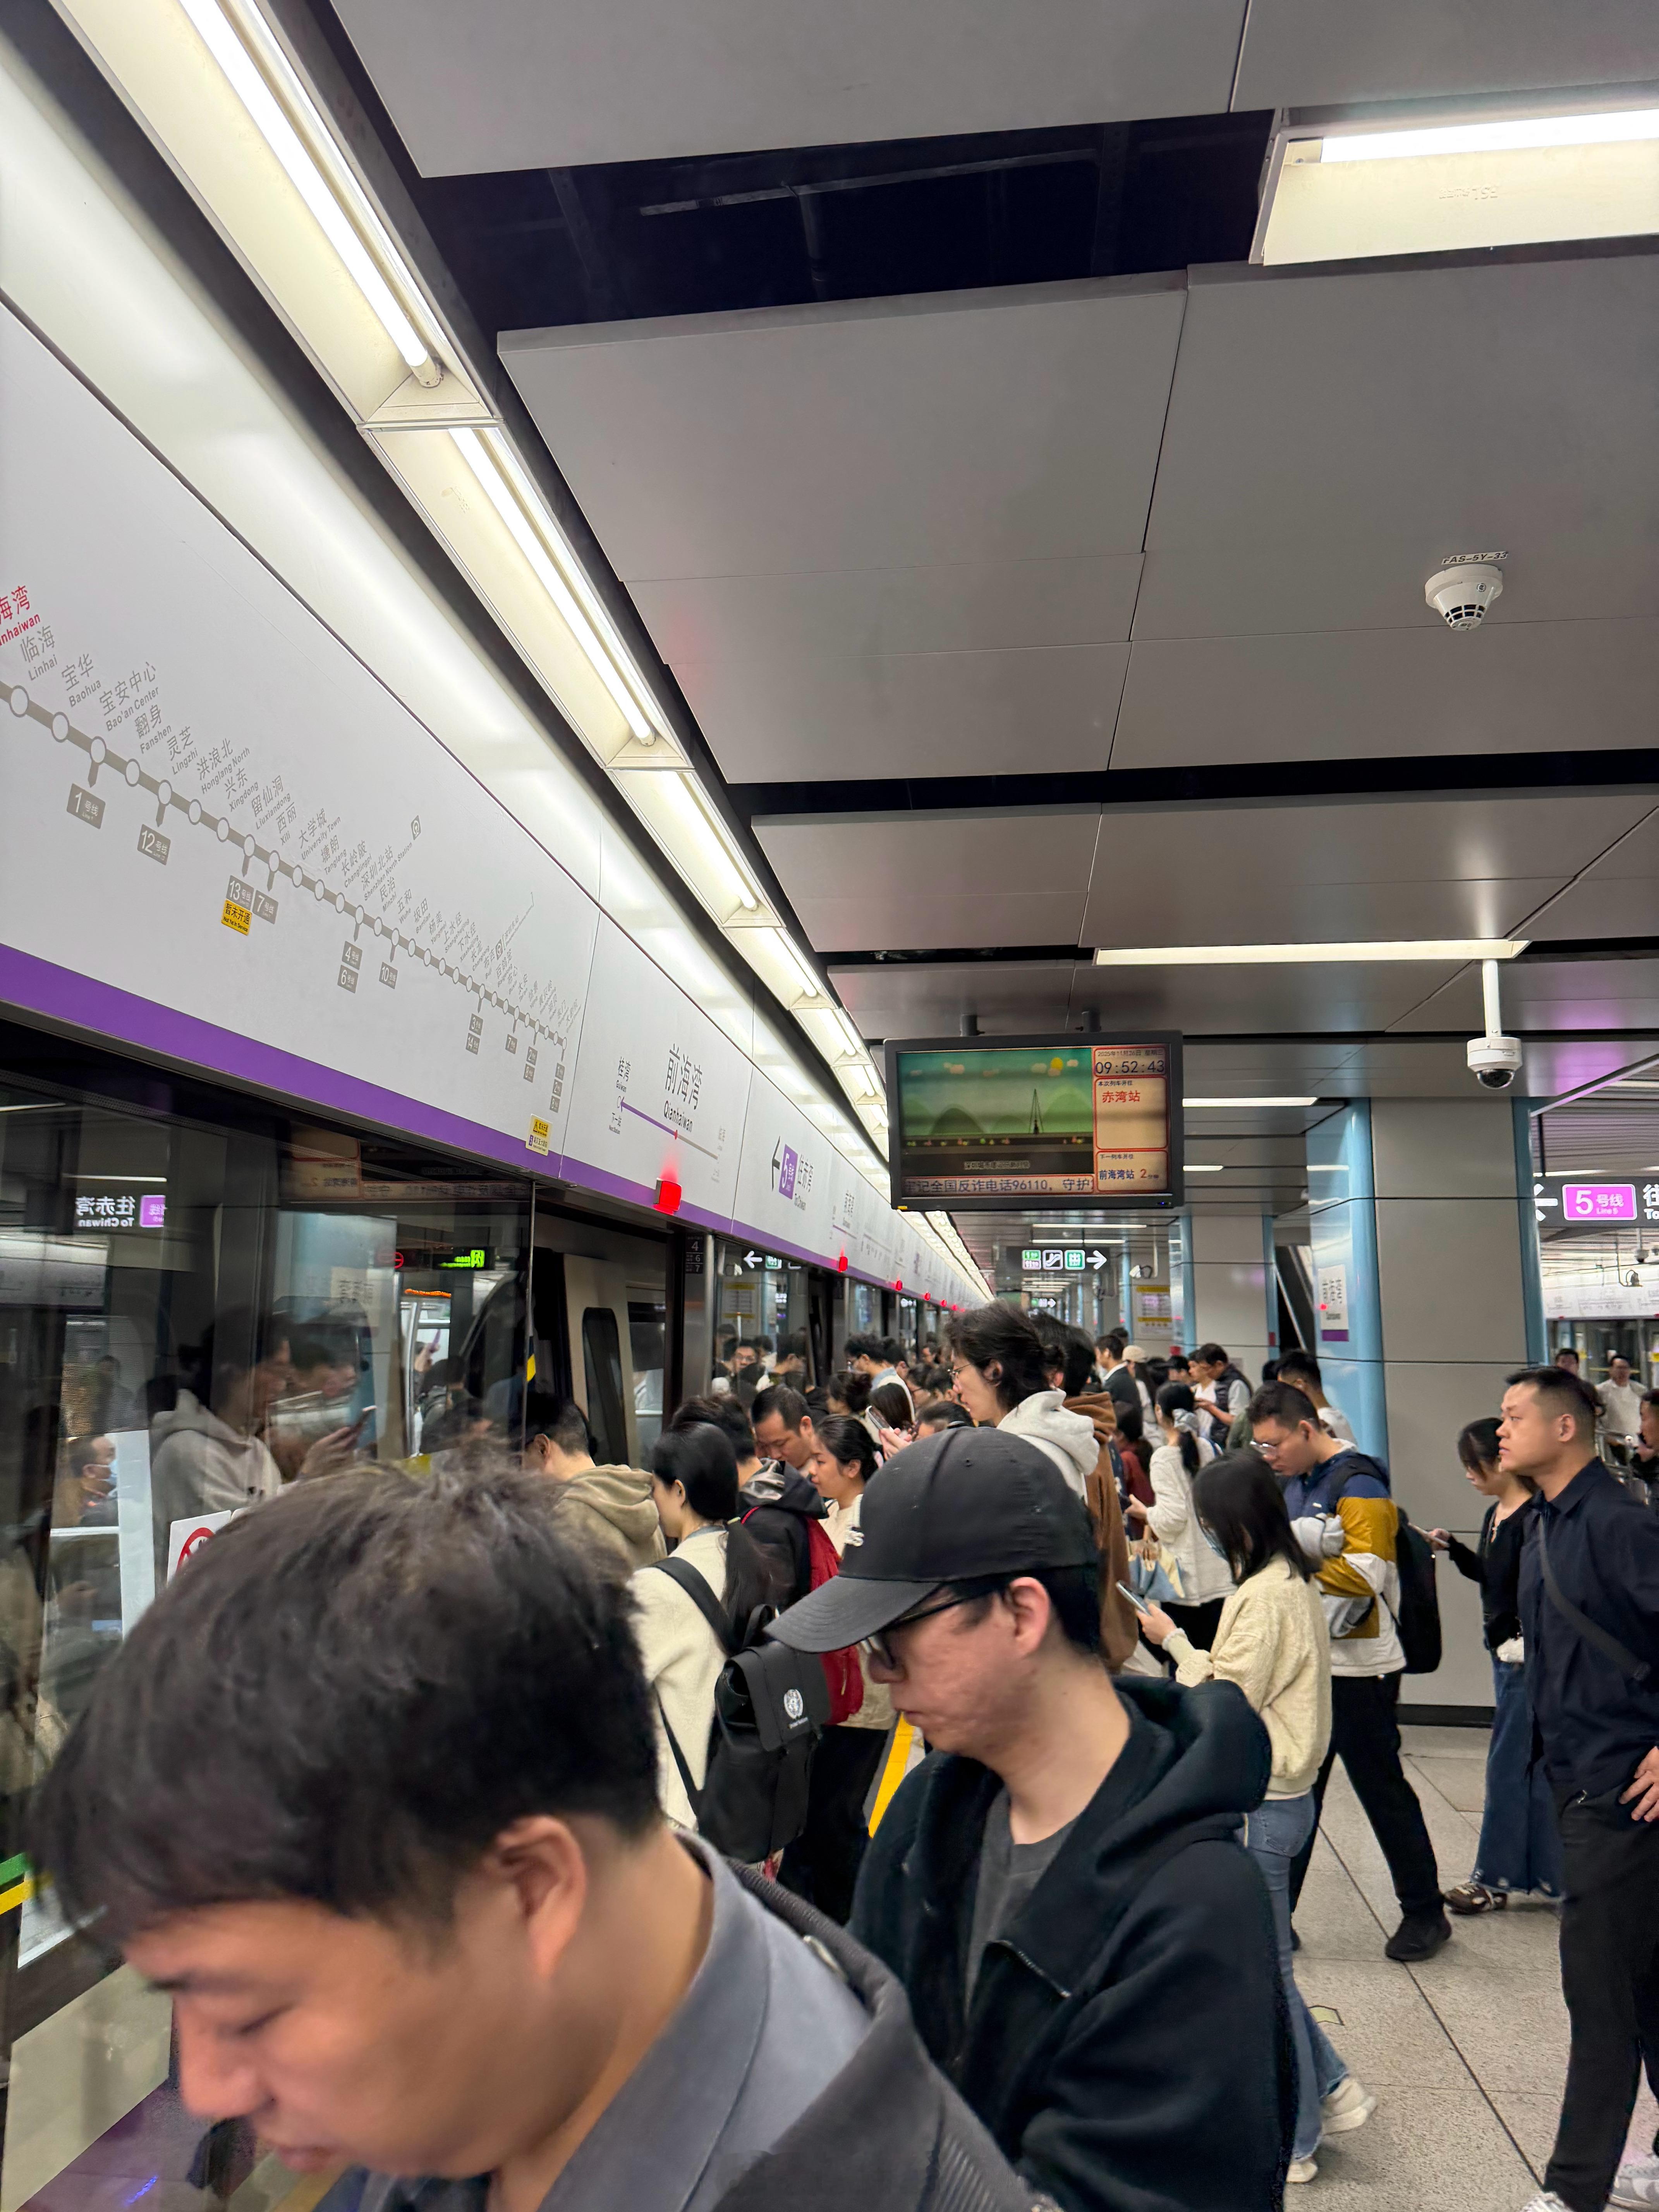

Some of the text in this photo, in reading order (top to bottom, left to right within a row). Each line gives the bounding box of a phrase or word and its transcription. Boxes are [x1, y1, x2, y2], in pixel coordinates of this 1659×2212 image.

[20, 625, 55, 663] 临海
[29, 654, 57, 681] Linhai
[62, 654, 93, 690] 宝华
[69, 680, 101, 707] Baohua
[100, 661, 156, 716] 宝安中心
[106, 687, 158, 731] Bao'an Center
[135, 704, 161, 738] 翻身
[140, 725, 172, 754] Fanshen
[167, 726, 193, 761] 灵芝
[172, 748, 198, 775] Lingzhi
[197, 738, 232, 780] 洪浪北
[202, 747, 250, 794] Honglang North
[225, 768, 247, 799] 兴东
[229, 781, 258, 812] Xingdong
[252, 775, 283, 817] 留仙洞
[256, 793, 290, 830] Liuxiandong
[276, 802, 296, 833] 西丽
[280, 831, 290, 845] Xili
[299, 808, 326, 849] 大学城
[301, 816, 341, 860] University Town
[321, 835, 339, 863] 塘朗
[324, 849, 347, 875] Tanglang
[342, 840, 367, 876] 长岭陂
[344, 854, 372, 888] Changlingpi
[361, 845, 393, 891] 深圳北站
[364, 843, 412, 901] Shenzhen North Station
[380, 877, 395, 902] 民治
[397, 889, 412, 914] 五和
[225, 903, 250, 925] 暂未开通
[414, 898, 428, 923] 坂田
[665, 1043, 702, 1109] 前海湾
[1103, 1090, 1140, 1103] 赤湾站
[664, 1100, 692, 1132] Qianhaiwan
[1099, 1169, 1134, 1180] 前海湾站
[691, 1241, 699, 1251] 4
